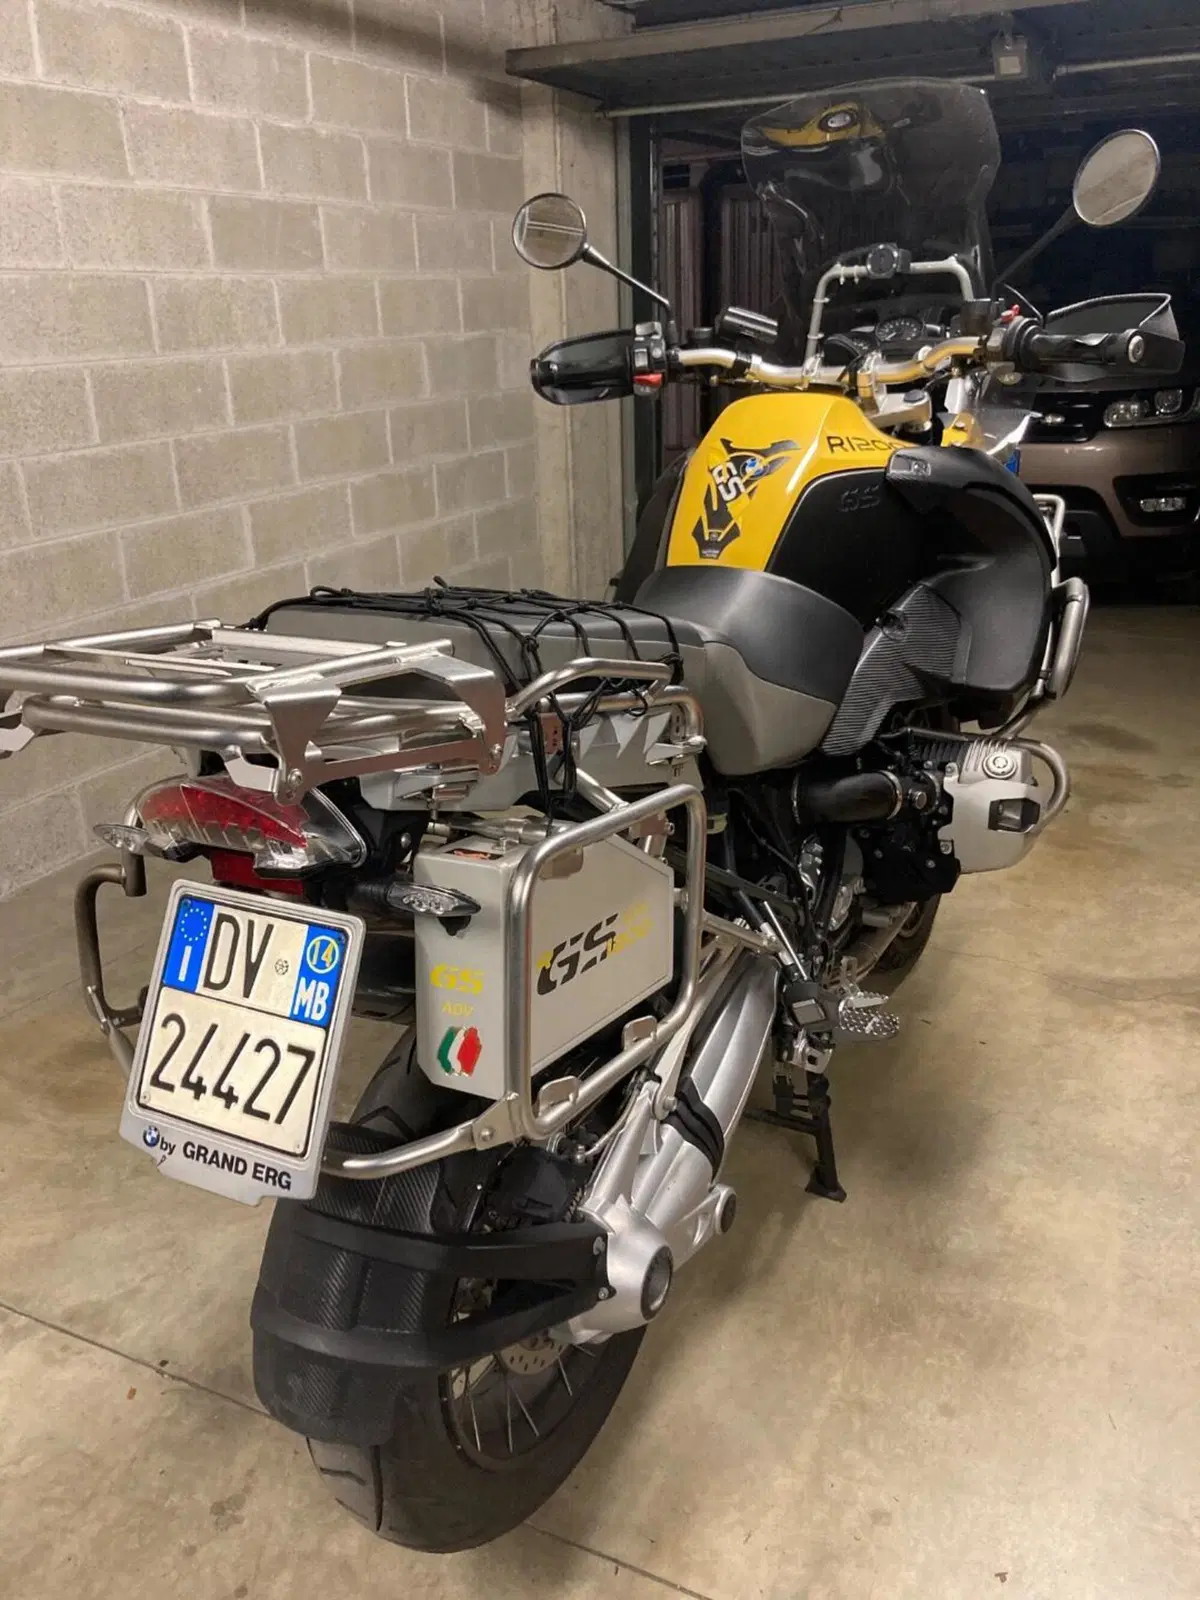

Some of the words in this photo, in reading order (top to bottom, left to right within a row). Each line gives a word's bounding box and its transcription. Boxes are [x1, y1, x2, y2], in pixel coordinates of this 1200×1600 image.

[712, 461, 746, 501] GS
[178, 945, 192, 982] I
[203, 913, 274, 998] DV
[311, 939, 334, 968] 14
[537, 913, 618, 995] GS
[293, 977, 331, 1021] MB
[430, 964, 484, 995] GS
[149, 1012, 316, 1125] 24427
[160, 1137, 176, 1155] by
[182, 1141, 247, 1175] GRAND
[252, 1162, 292, 1191] ERG
